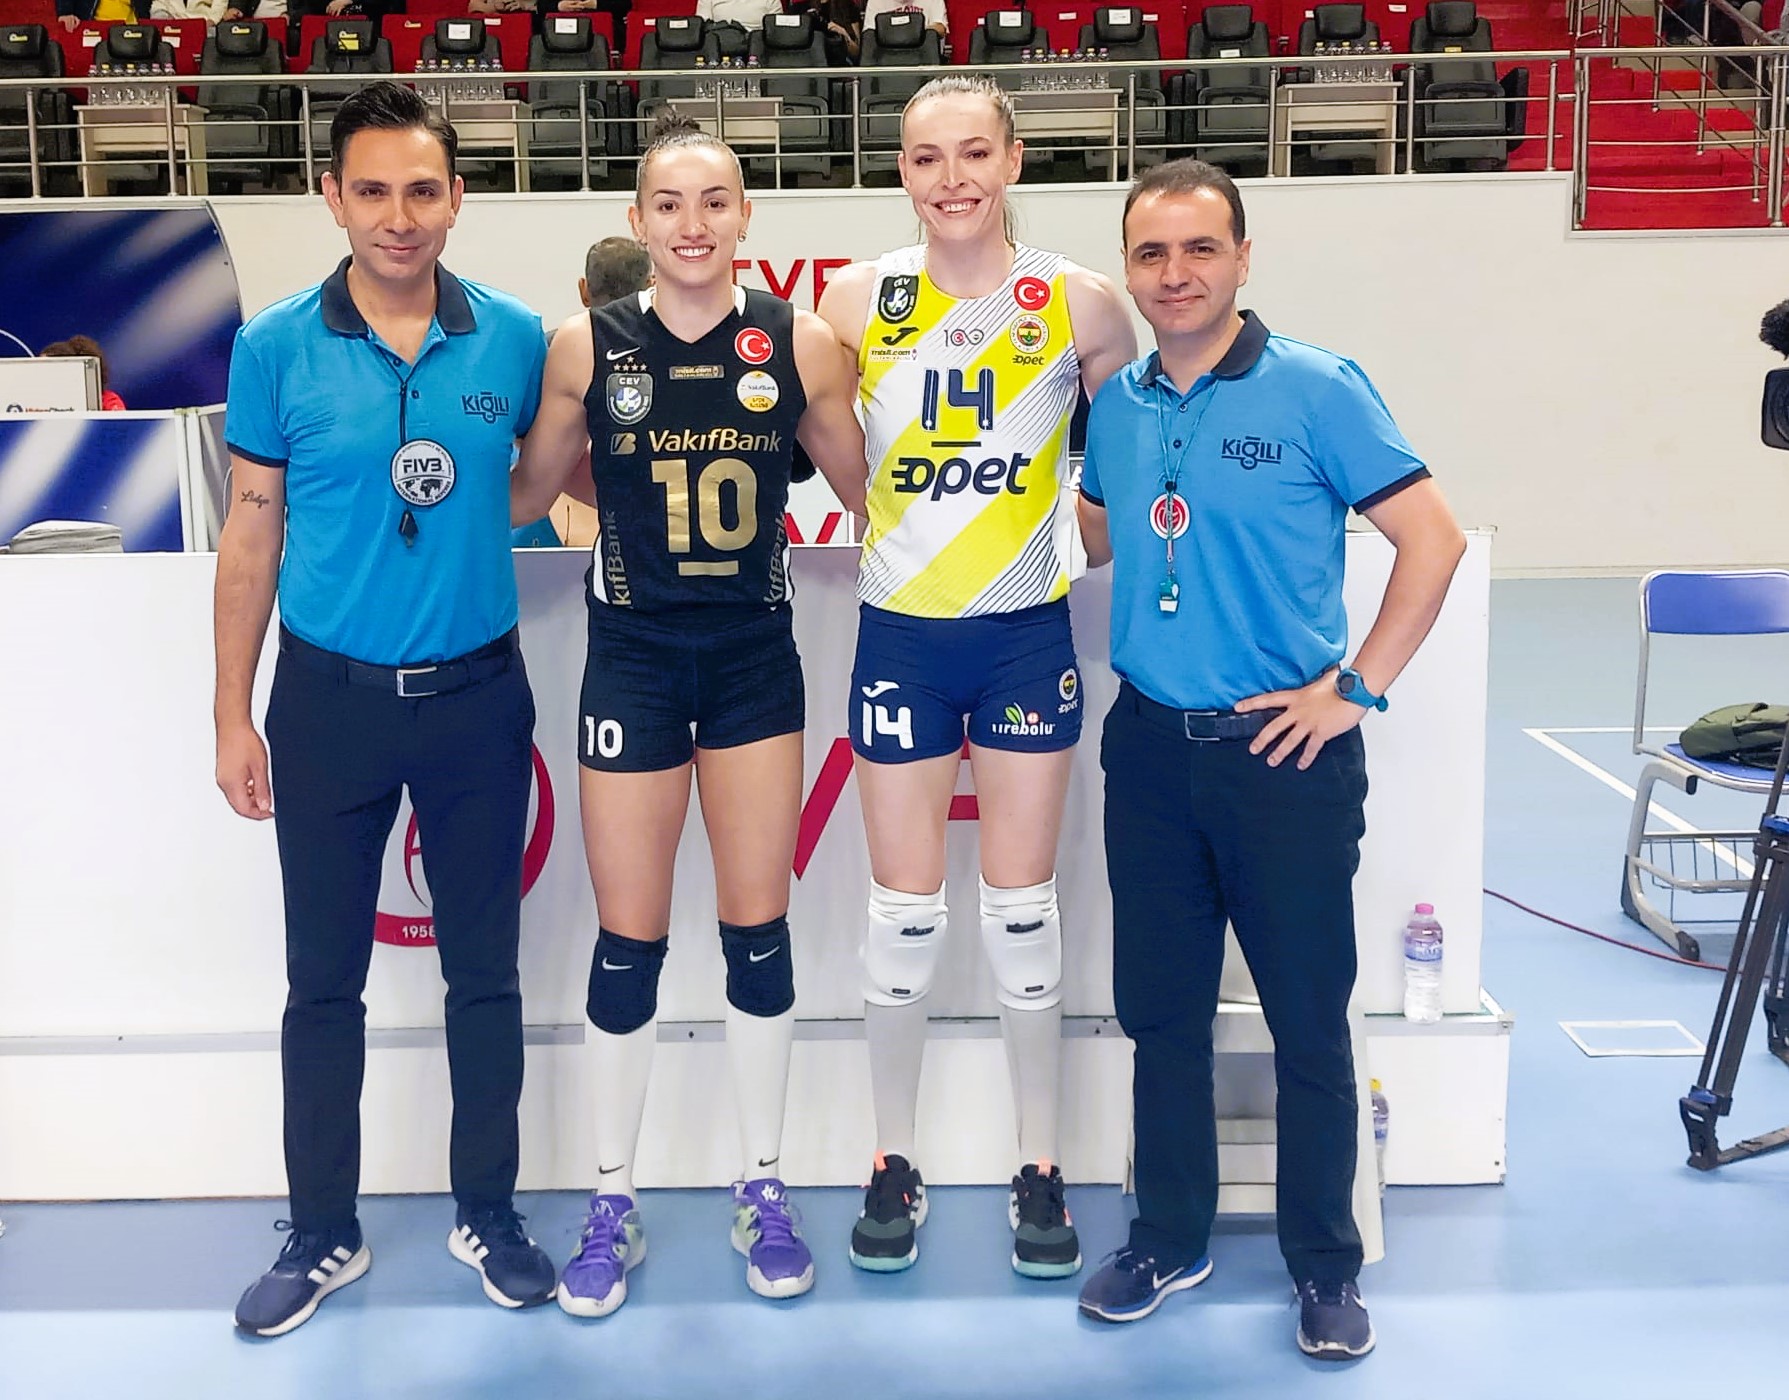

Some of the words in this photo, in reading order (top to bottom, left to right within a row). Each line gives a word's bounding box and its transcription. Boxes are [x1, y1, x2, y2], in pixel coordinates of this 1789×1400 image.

[893, 277, 911, 288] CEV
[618, 376, 641, 386] CEV
[921, 367, 994, 431] 14
[648, 428, 782, 452] VakıfBank
[402, 457, 442, 473] FIVB
[891, 452, 1032, 501] opet
[650, 457, 758, 553] 10
[584, 714, 624, 758] 10
[862, 700, 915, 750] 14
